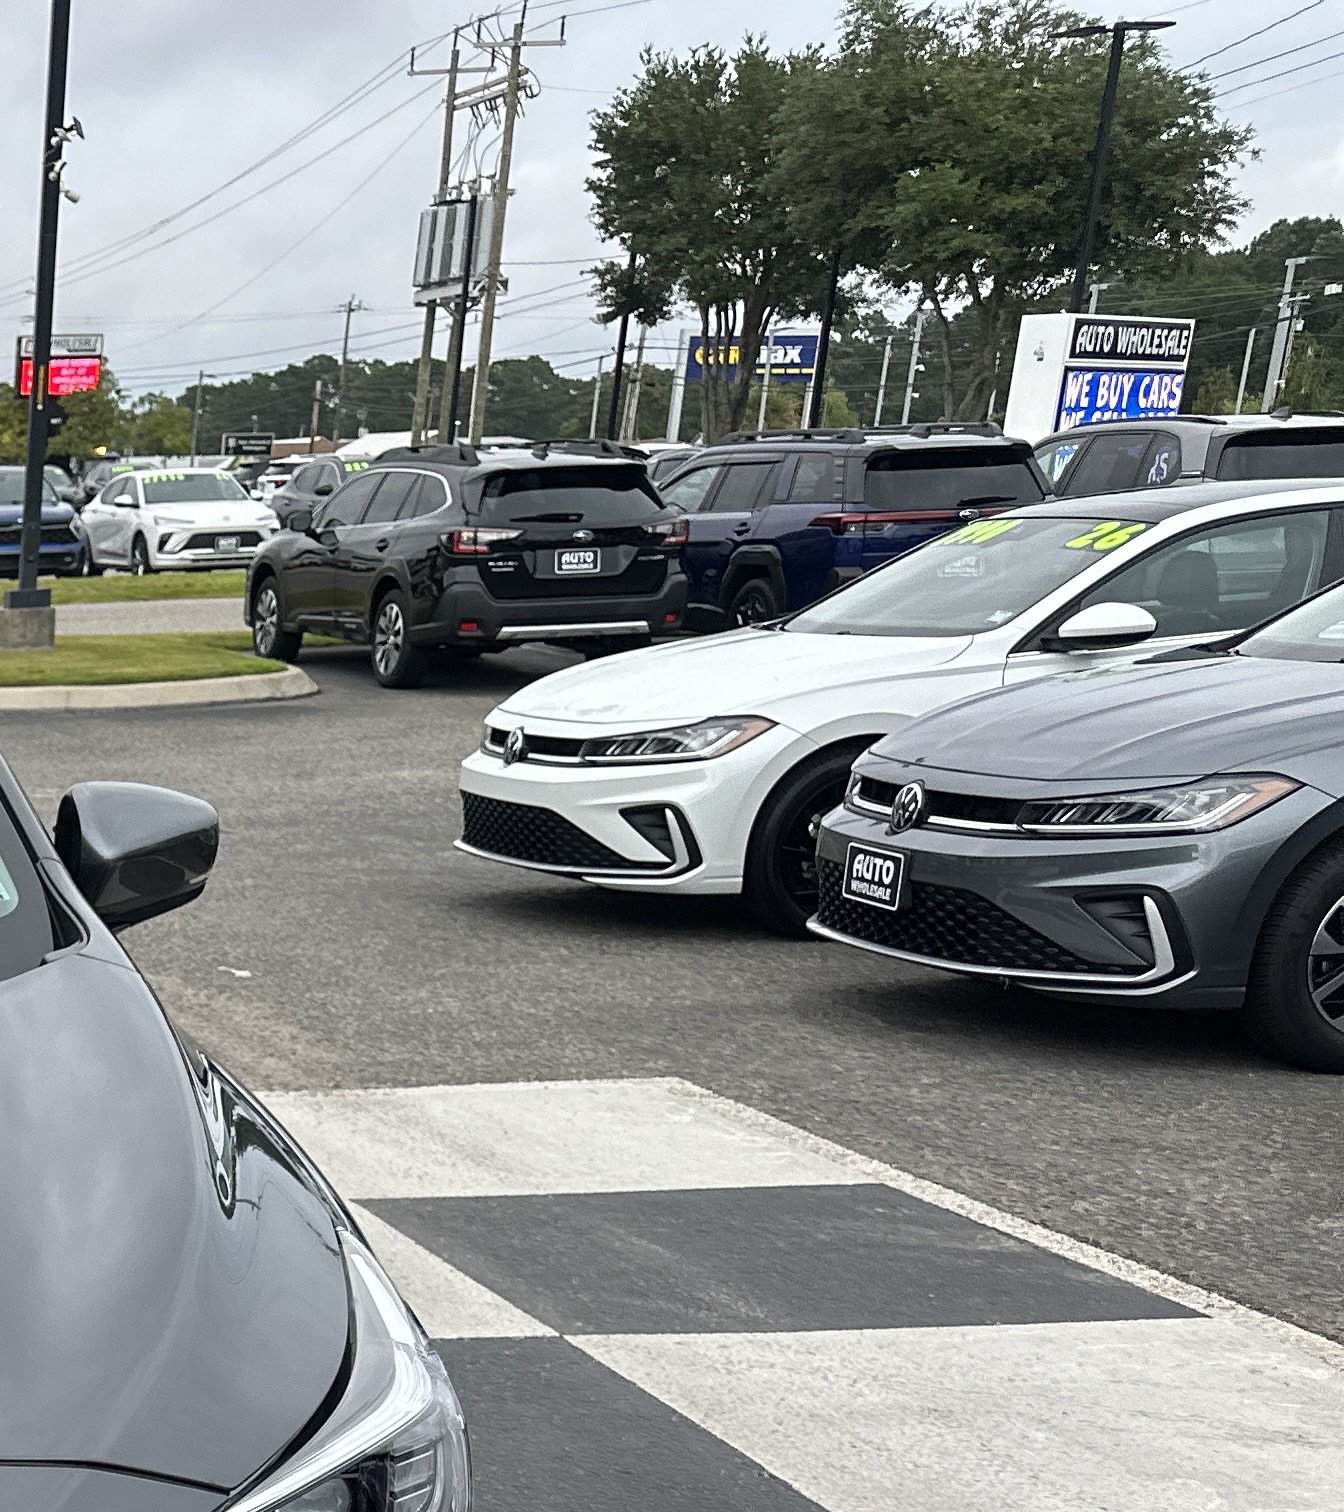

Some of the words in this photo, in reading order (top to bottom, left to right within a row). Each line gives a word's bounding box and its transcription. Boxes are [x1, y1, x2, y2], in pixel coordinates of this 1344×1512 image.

[1076, 325, 1114, 354] AUTO
[1116, 327, 1189, 357] WHOLESALE
[1065, 371, 1093, 408] WE
[1096, 374, 1134, 409] BUY
[1138, 375, 1183, 409] CARS
[1065, 521, 1146, 550] 26
[562, 552, 595, 564] AUTO
[852, 853, 895, 885] AUTO
